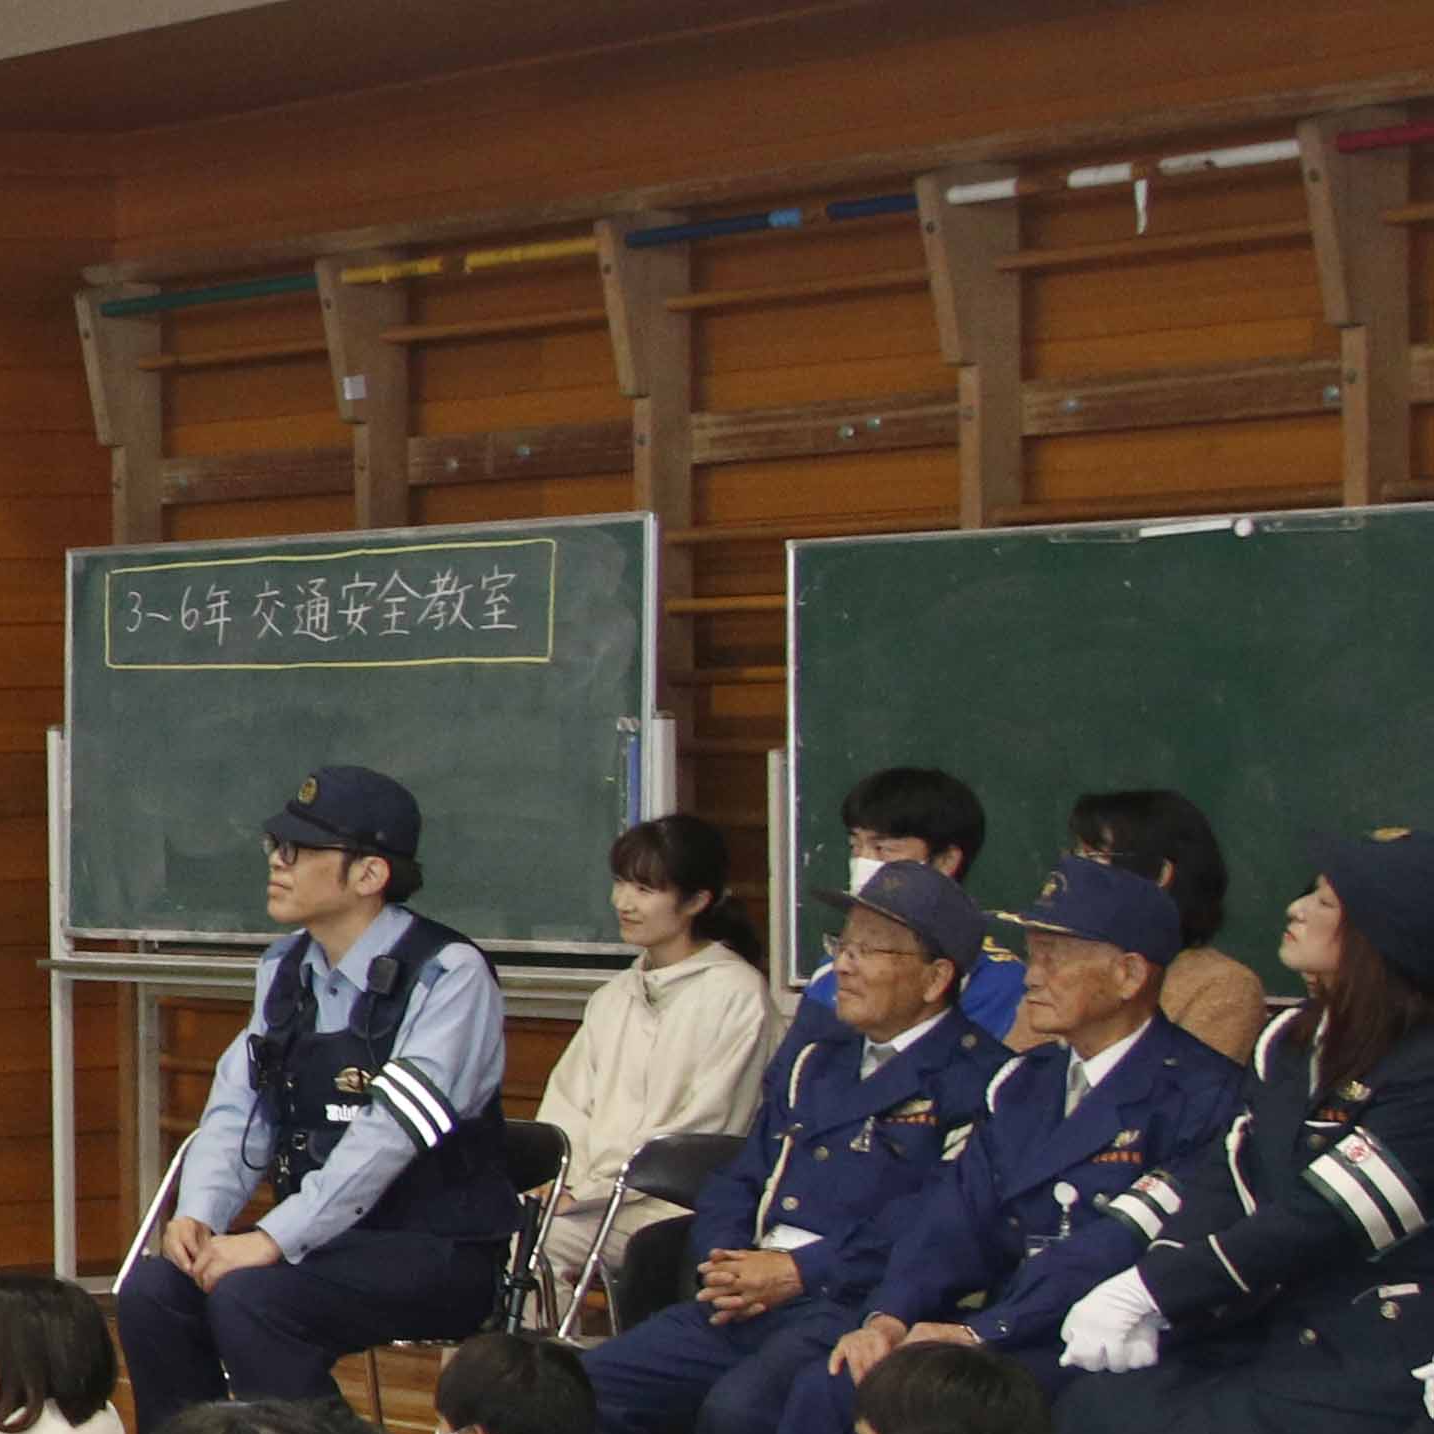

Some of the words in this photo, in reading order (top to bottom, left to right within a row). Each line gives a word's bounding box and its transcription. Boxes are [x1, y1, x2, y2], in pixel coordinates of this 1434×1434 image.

[252, 564, 518, 642] 交通安全教室
